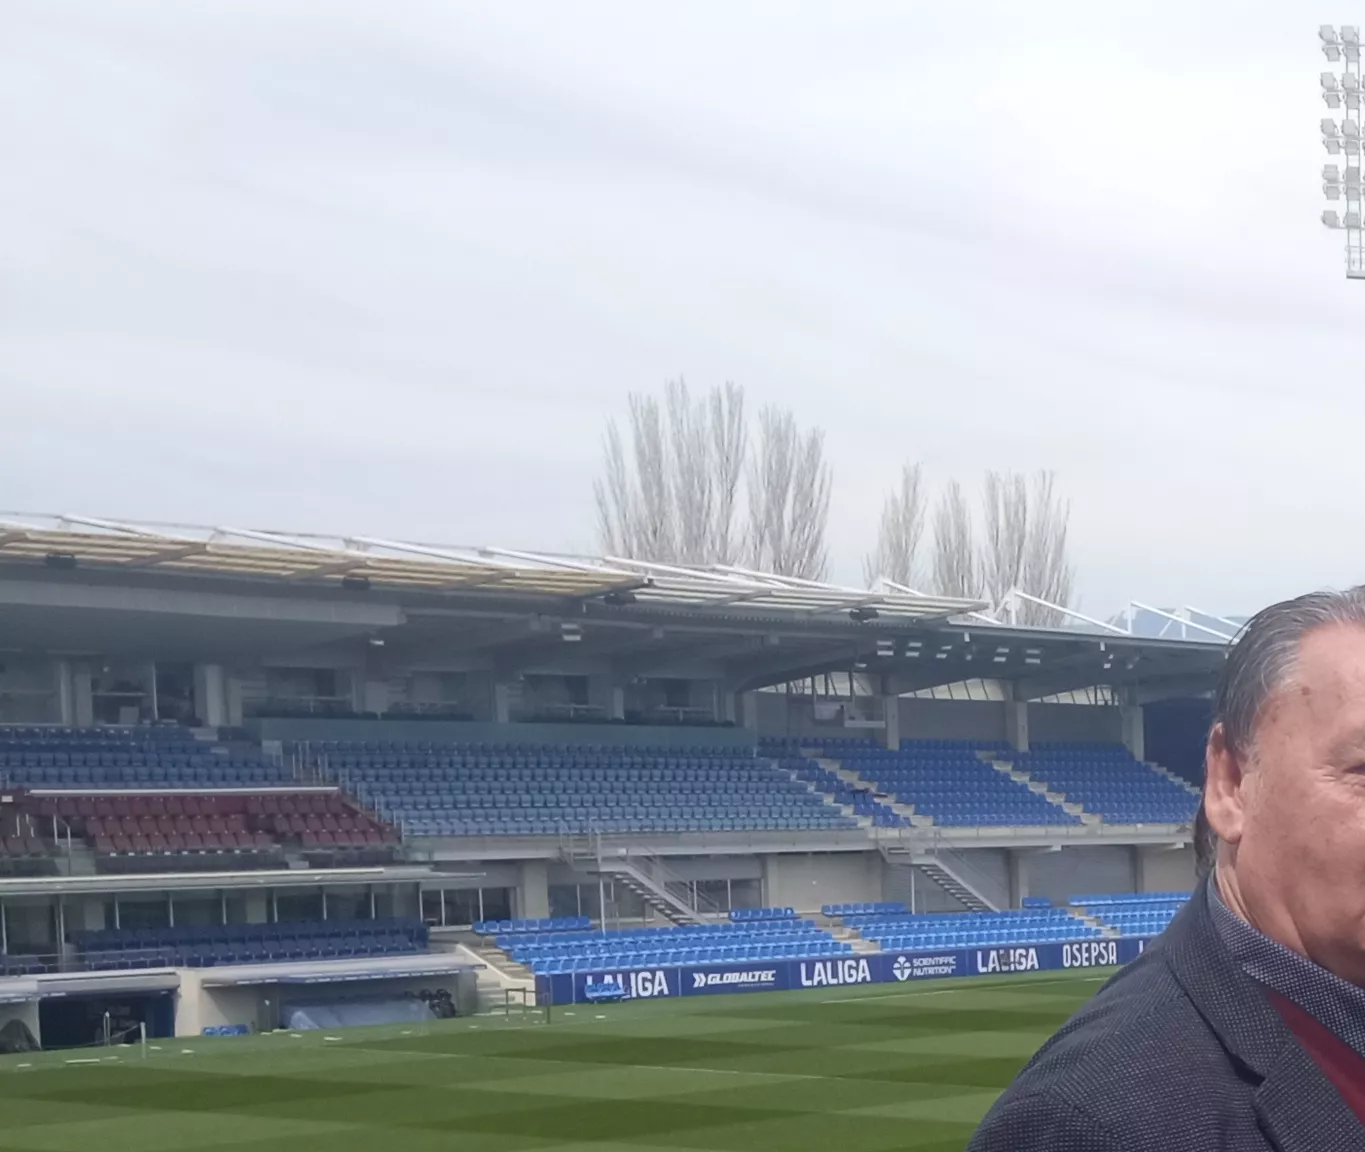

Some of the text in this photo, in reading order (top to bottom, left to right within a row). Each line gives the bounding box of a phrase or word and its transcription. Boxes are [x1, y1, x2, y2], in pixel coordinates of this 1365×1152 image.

[1062, 941, 1117, 968] OSEPSA
[707, 970, 776, 985] GLOBALTEC
[800, 958, 871, 987] LALIGA
